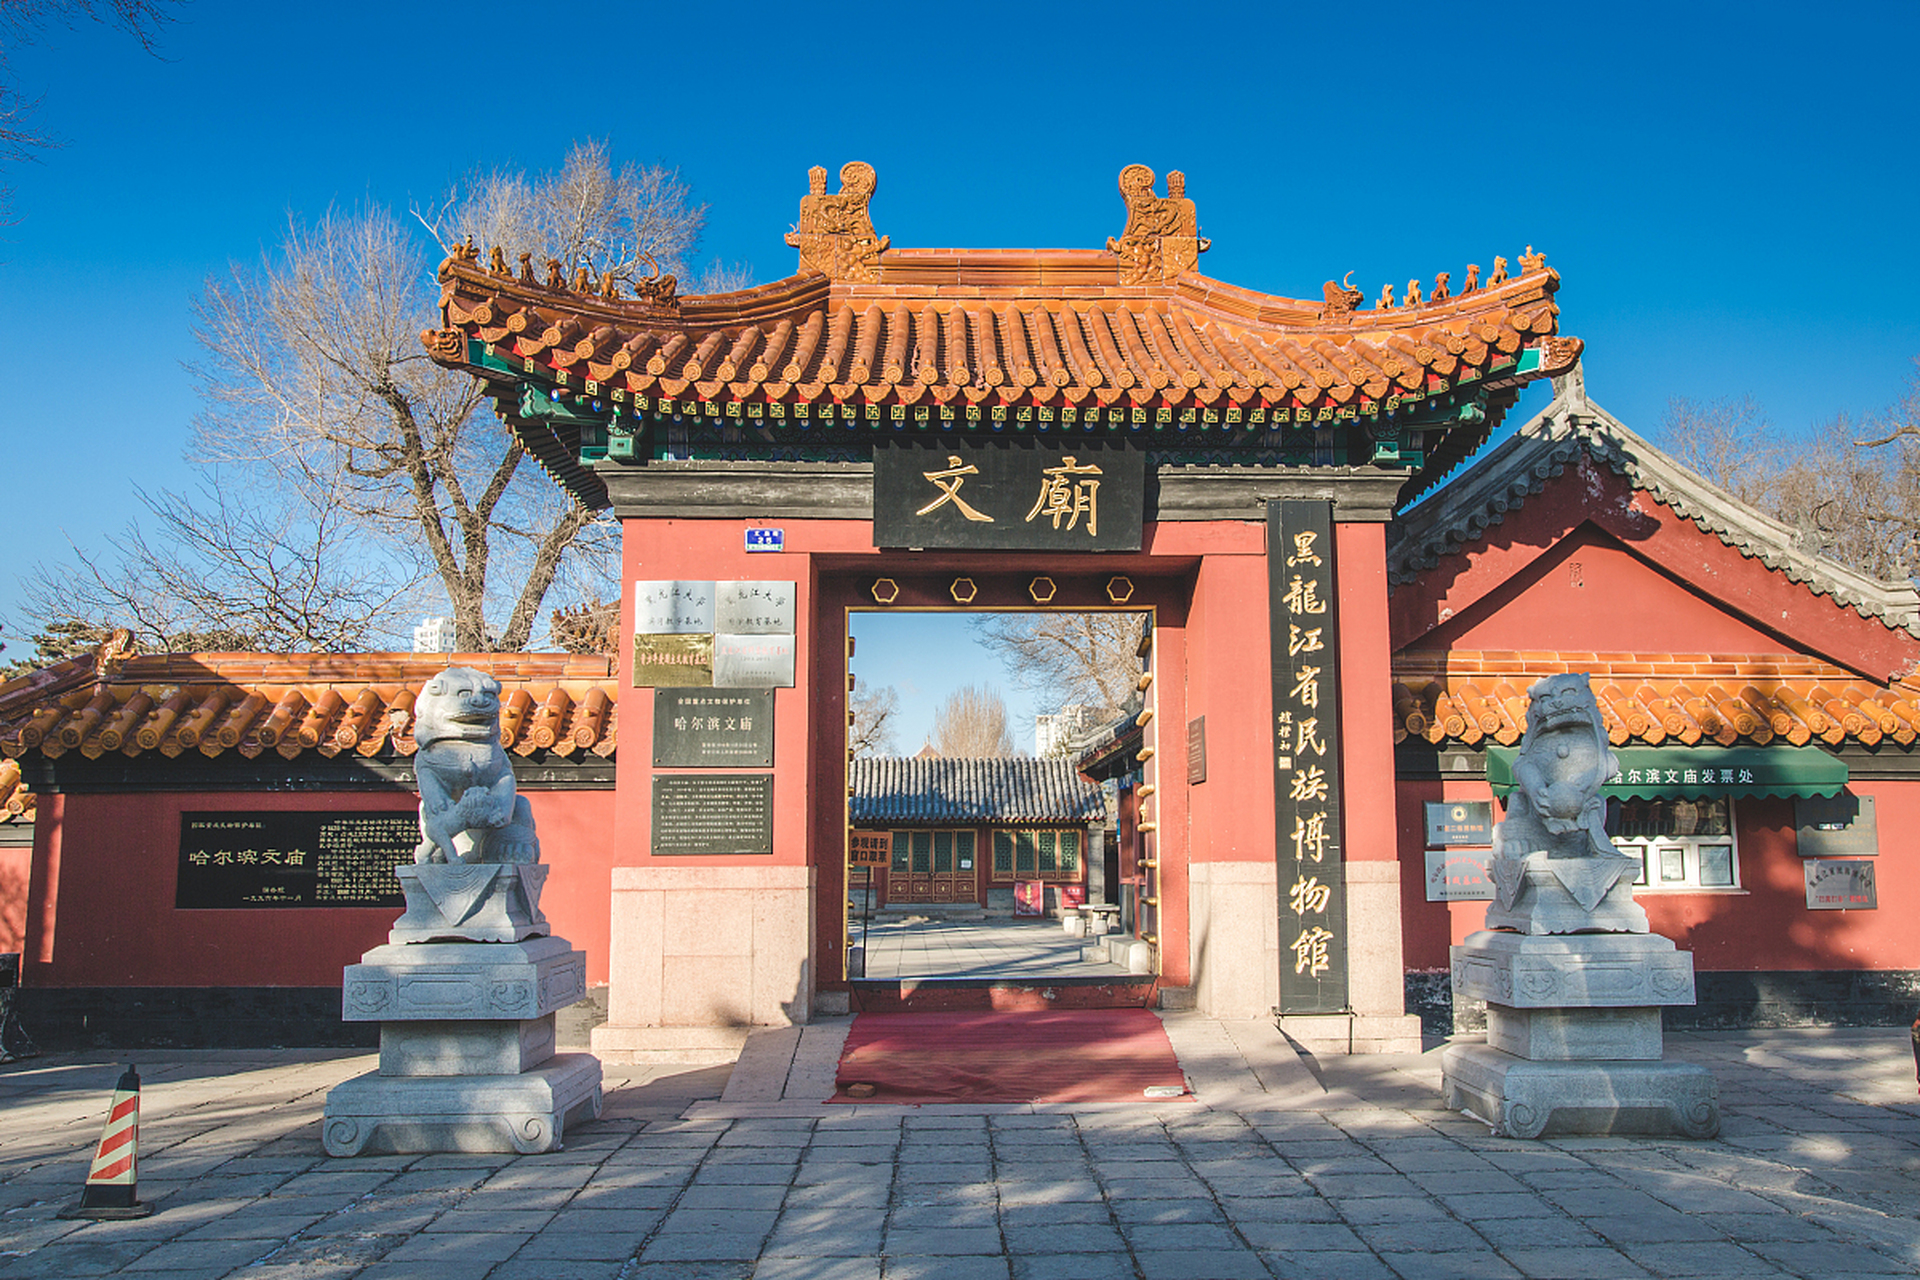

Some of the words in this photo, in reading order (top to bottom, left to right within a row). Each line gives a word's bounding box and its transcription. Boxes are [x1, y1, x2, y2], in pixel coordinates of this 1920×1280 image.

[916, 455, 1103, 537] 文廟
[674, 716, 753, 731] 哈尔滨文庙
[1282, 530, 1335, 979] 黑龍江省民族博物館
[188, 848, 307, 866] 哈尔滨文庙
